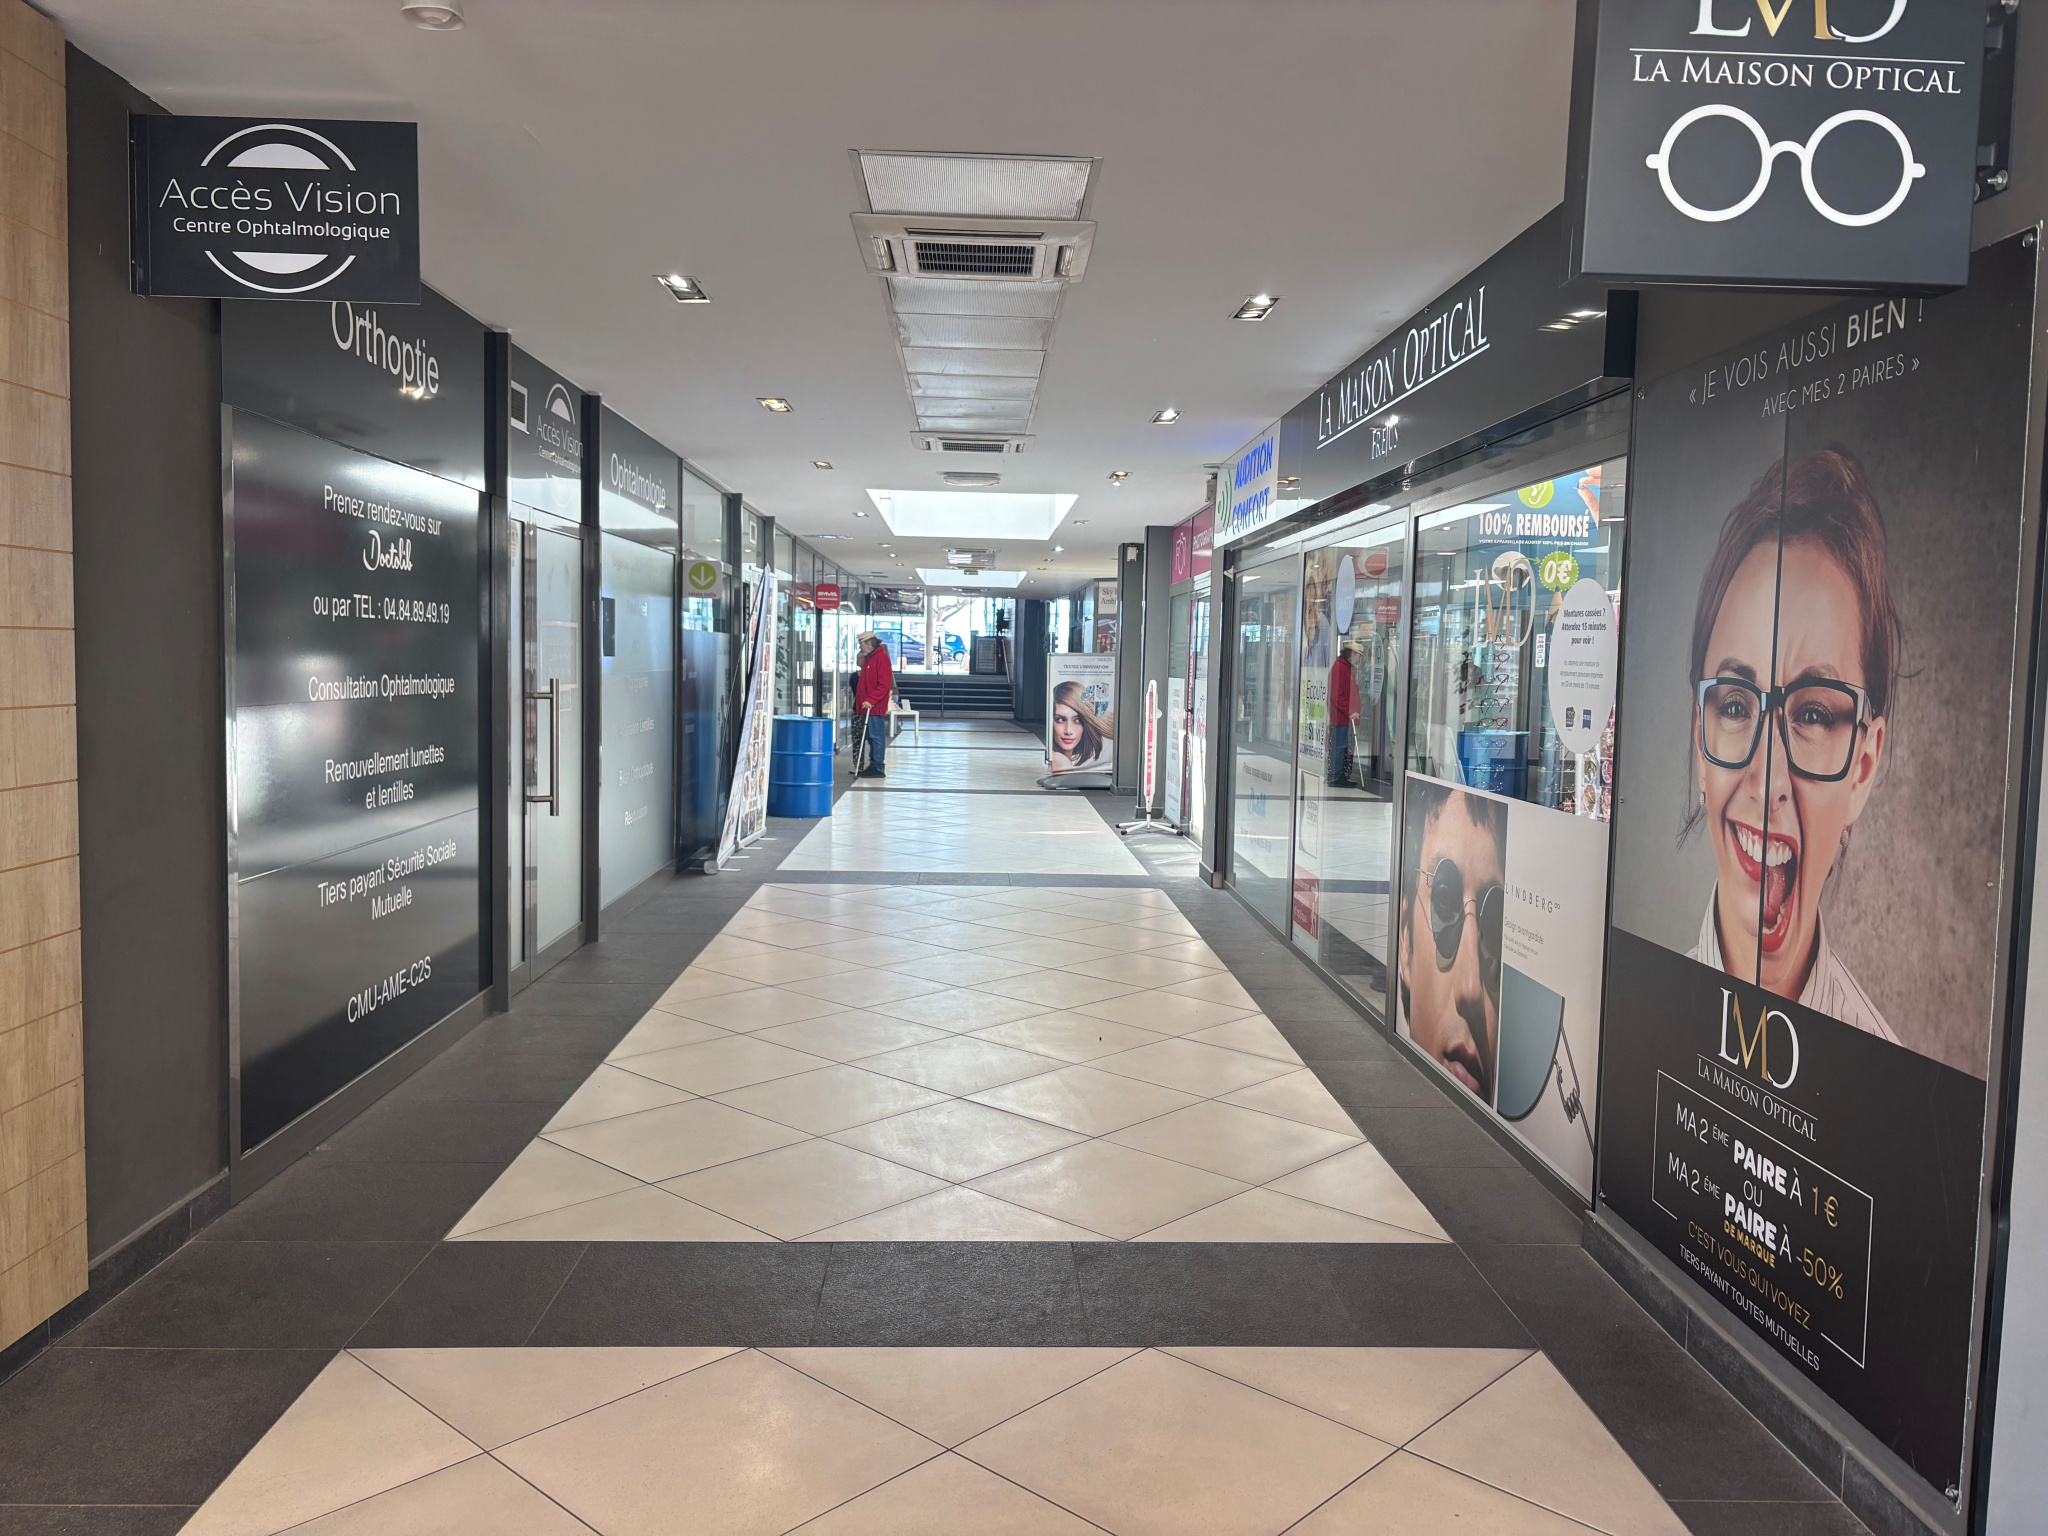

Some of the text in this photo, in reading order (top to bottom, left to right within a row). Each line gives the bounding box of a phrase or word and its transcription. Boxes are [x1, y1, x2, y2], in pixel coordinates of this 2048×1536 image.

[1632, 54, 1962, 95] LA MAISON OPTICAL
[159, 178, 401, 216] Accès Vision
[172, 217, 391, 242] Centre Ophtalmologique
[331, 301, 440, 395] Orthoptie
[1318, 285, 1488, 442] LA MAISON OPTICAL
[1701, 369, 1717, 405] JE
[1724, 349, 1768, 392] VOIS
[1776, 322, 1837, 375] AUSSI
[1846, 297, 1906, 349] BIEN
[1762, 389, 1797, 418] AVEC
[1801, 378, 1831, 406] MES
[1836, 373, 1846, 396] 2
[1852, 353, 1905, 389] PAIRES
[535, 415, 584, 459] Accès Vision
[610, 452, 666, 513] Ophtalmologie
[1234, 435, 1274, 491] AUDITION
[323, 484, 442, 536] Prenez rendez-vous sur
[1231, 486, 1271, 535] CONFORT
[1478, 509, 1590, 538] 100% REMBOURSÉ
[363, 530, 414, 572] Doctolib
[1543, 560, 1573, 584] 0€
[313, 597, 330, 616] ou
[332, 597, 351, 622] par
[353, 593, 376, 620] TEL
[383, 601, 451, 624] 04.84.89.49.19
[1561, 622, 1581, 631] Attendez
[308, 673, 455, 702] Consultation Ophtalmologique
[325, 745, 445, 784] Renouvellement lunettes
[366, 780, 415, 810] et lentilles
[317, 839, 458, 908] Tiers payant Sécurité Sociale
[1505, 882, 1553, 914] LINDBERG
[371, 886, 413, 921] Mutuelle
[347, 956, 433, 1024] CMU-AME-C2S
[1697, 1058, 1817, 1142] LA MAISON OPTICAL
[1676, 1102, 1697, 1138] MA
[1699, 1117, 1709, 1145] 2
[1733, 1139, 1788, 1196] PAIRE
[1789, 1167, 1803, 1207] À
[1743, 1180, 1764, 1208] OU
[1668, 1152, 1689, 1188] MA
[1690, 1169, 1700, 1195] 2
[1724, 1192, 1777, 1251] PAIRE
[1779, 1223, 1793, 1264] À
[1795, 1247, 1845, 1301] -50%
[1723, 1219, 1776, 1269] DE MARQUE
[1688, 1221, 1811, 1332] C'EST VOUS QUI VOYEZ
[1679, 1243, 1821, 1371] TIERS PAYANT TOUTES MUTUELLES
